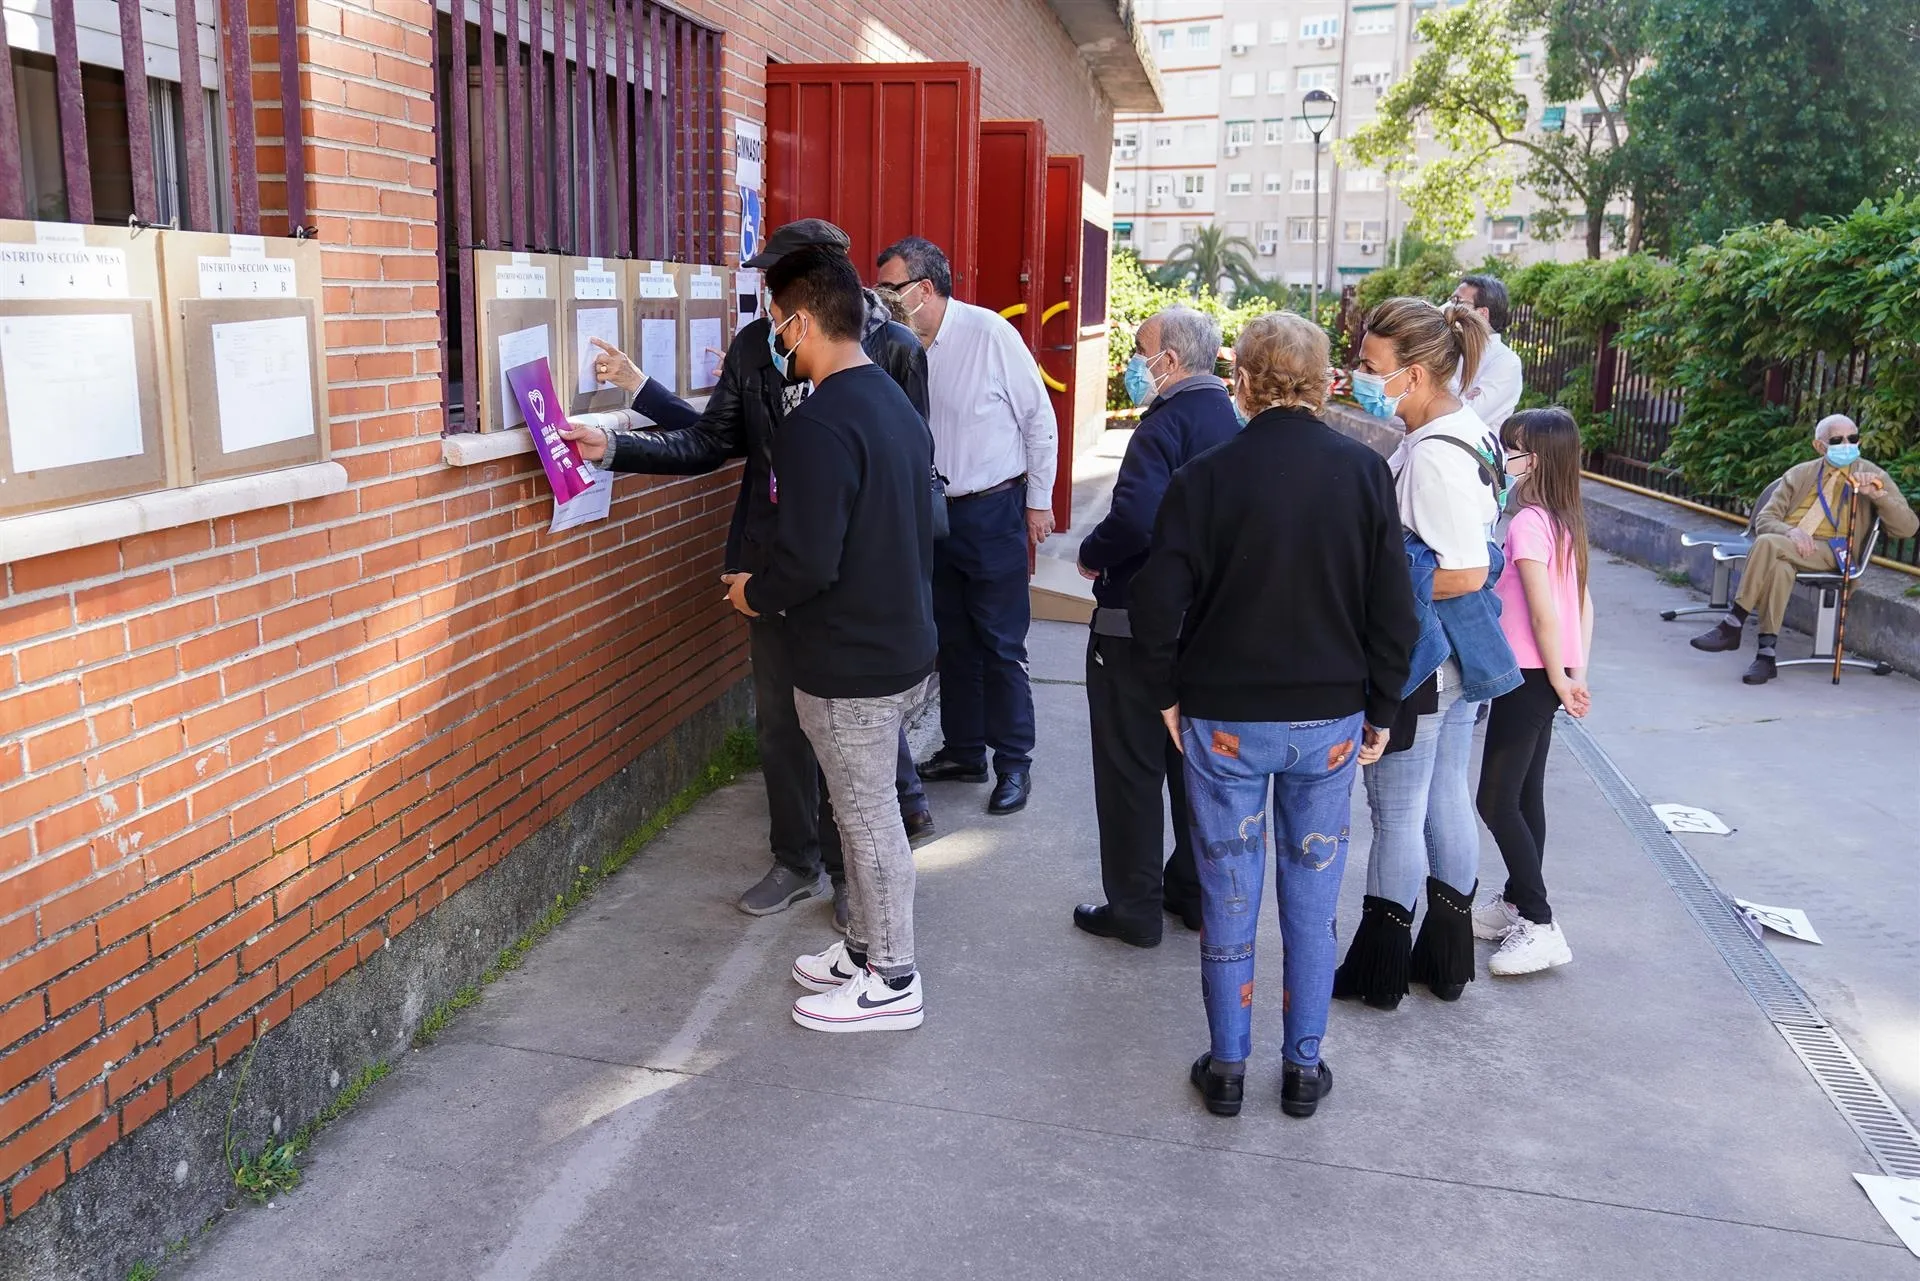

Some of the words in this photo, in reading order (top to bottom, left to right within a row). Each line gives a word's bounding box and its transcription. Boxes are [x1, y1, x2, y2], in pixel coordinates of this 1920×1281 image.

[0, 250, 45, 264] ISTRITO
[200, 262, 236, 273] DISTRITO
[1667, 811, 1713, 829] 2A
